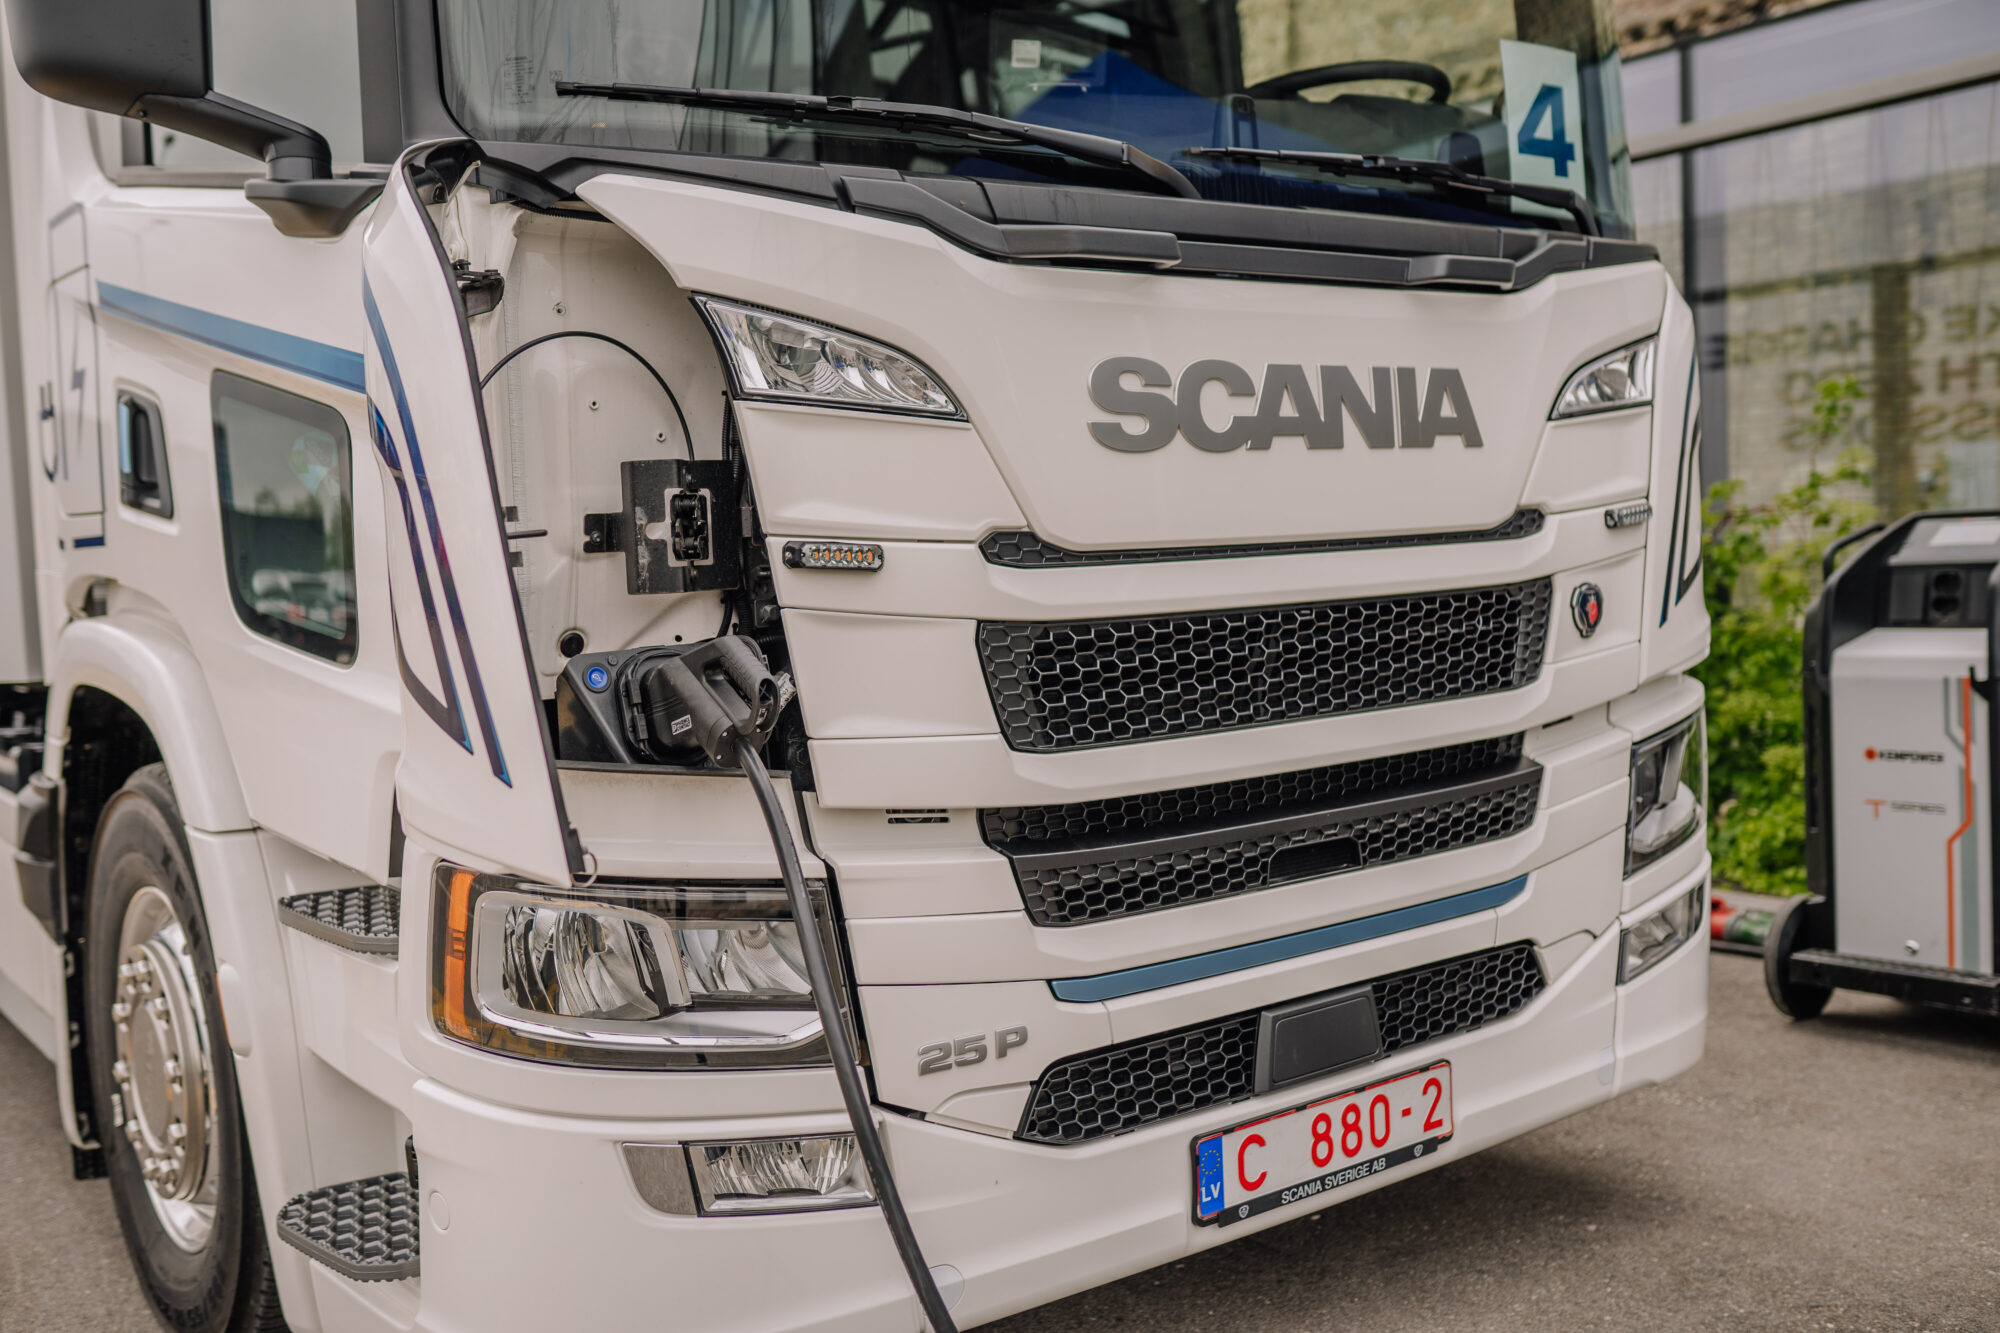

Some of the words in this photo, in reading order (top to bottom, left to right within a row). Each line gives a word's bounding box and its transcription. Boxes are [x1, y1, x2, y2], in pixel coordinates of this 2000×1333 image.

[1517, 83, 1576, 178] 4
[1087, 356, 1484, 452] SCANIA
[1879, 750, 1944, 763] KEMPOWER
[917, 1033, 988, 1076] 25
[994, 1024, 1028, 1059] P
[1237, 1133, 1268, 1191] C
[1281, 1179, 1323, 1205] SCANIA
[1325, 1163, 1370, 1190] SVERIGE
[1372, 1158, 1386, 1174] AB
[1200, 1181, 1221, 1203] LV
